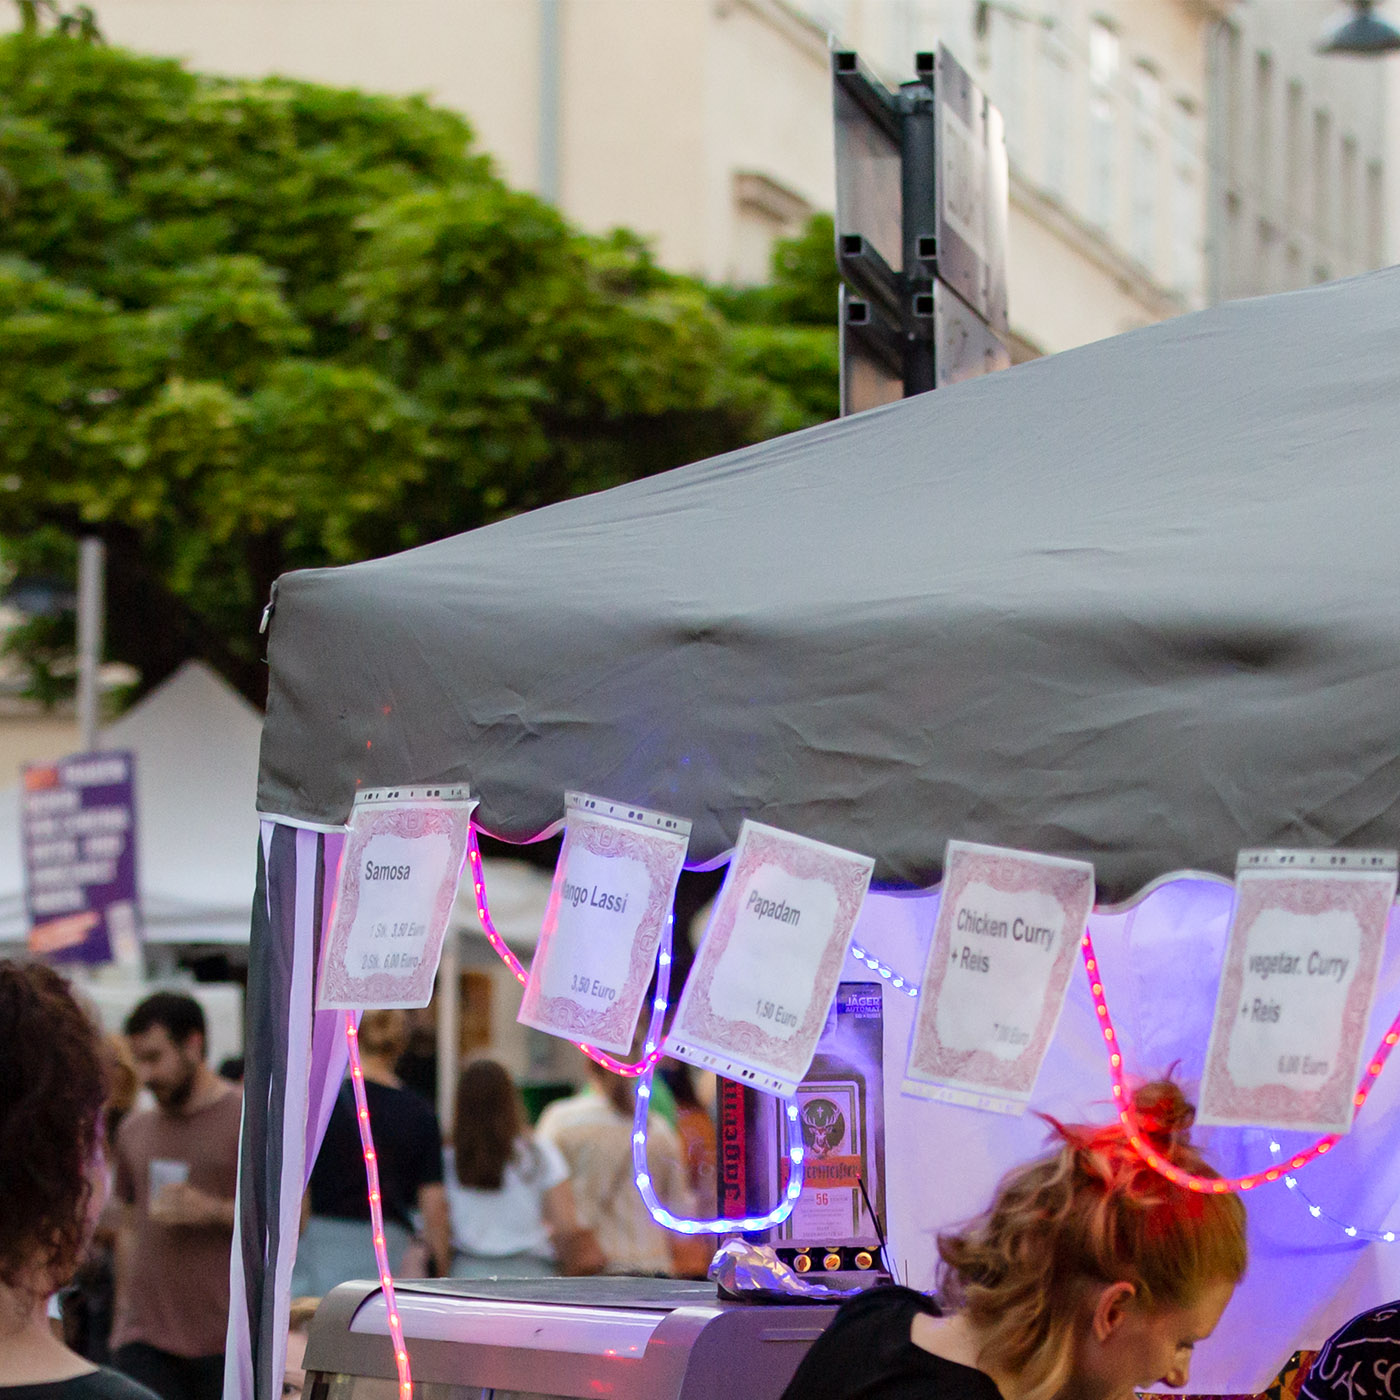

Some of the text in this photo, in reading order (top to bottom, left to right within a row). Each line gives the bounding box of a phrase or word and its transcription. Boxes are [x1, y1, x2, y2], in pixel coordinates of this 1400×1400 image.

[365, 861, 411, 880] Samosa
[563, 881, 628, 913] ango Lassi
[746, 889, 800, 926] Papadam
[957, 908, 1055, 952] Chicken Curry
[960, 946, 990, 973] Reis
[1307, 949, 1350, 983] Curry
[571, 974, 616, 1001] 3,50 Euro
[846, 994, 880, 1006] JÄGER
[755, 999, 798, 1028] 1,50 Euro
[1251, 998, 1281, 1023] Reis
[816, 1192, 829, 1206] 56
